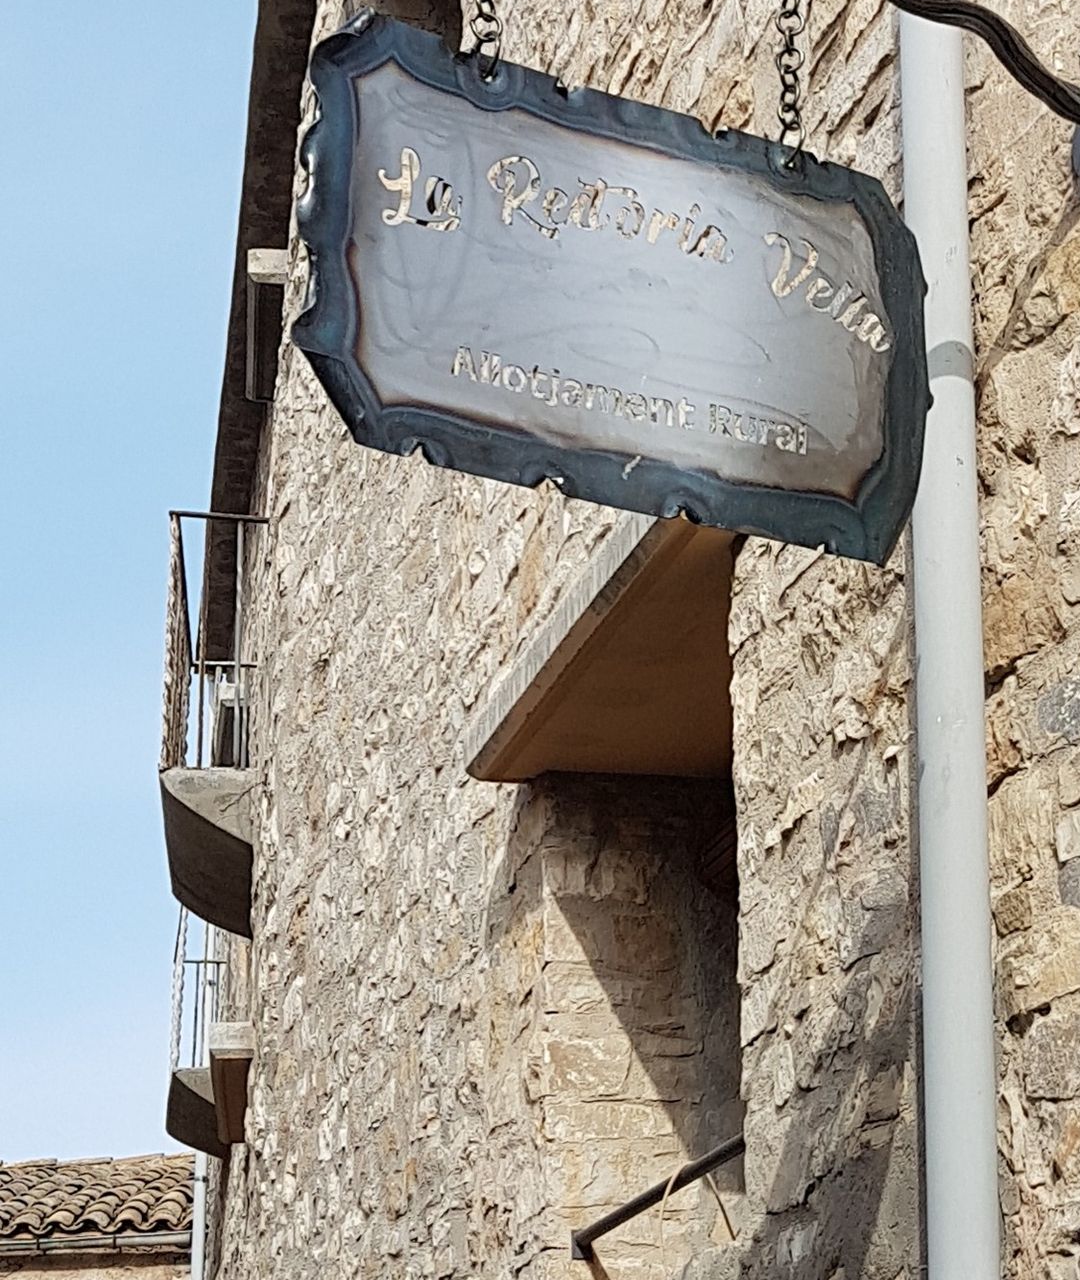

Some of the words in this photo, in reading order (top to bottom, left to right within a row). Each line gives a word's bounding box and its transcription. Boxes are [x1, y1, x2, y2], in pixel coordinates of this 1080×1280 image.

[378, 146, 463, 233] La
[486, 155, 735, 264] Rectoria
[762, 231, 890, 353] Vella
[451, 345, 697, 431] Allotjament
[708, 403, 808, 457] Rural
